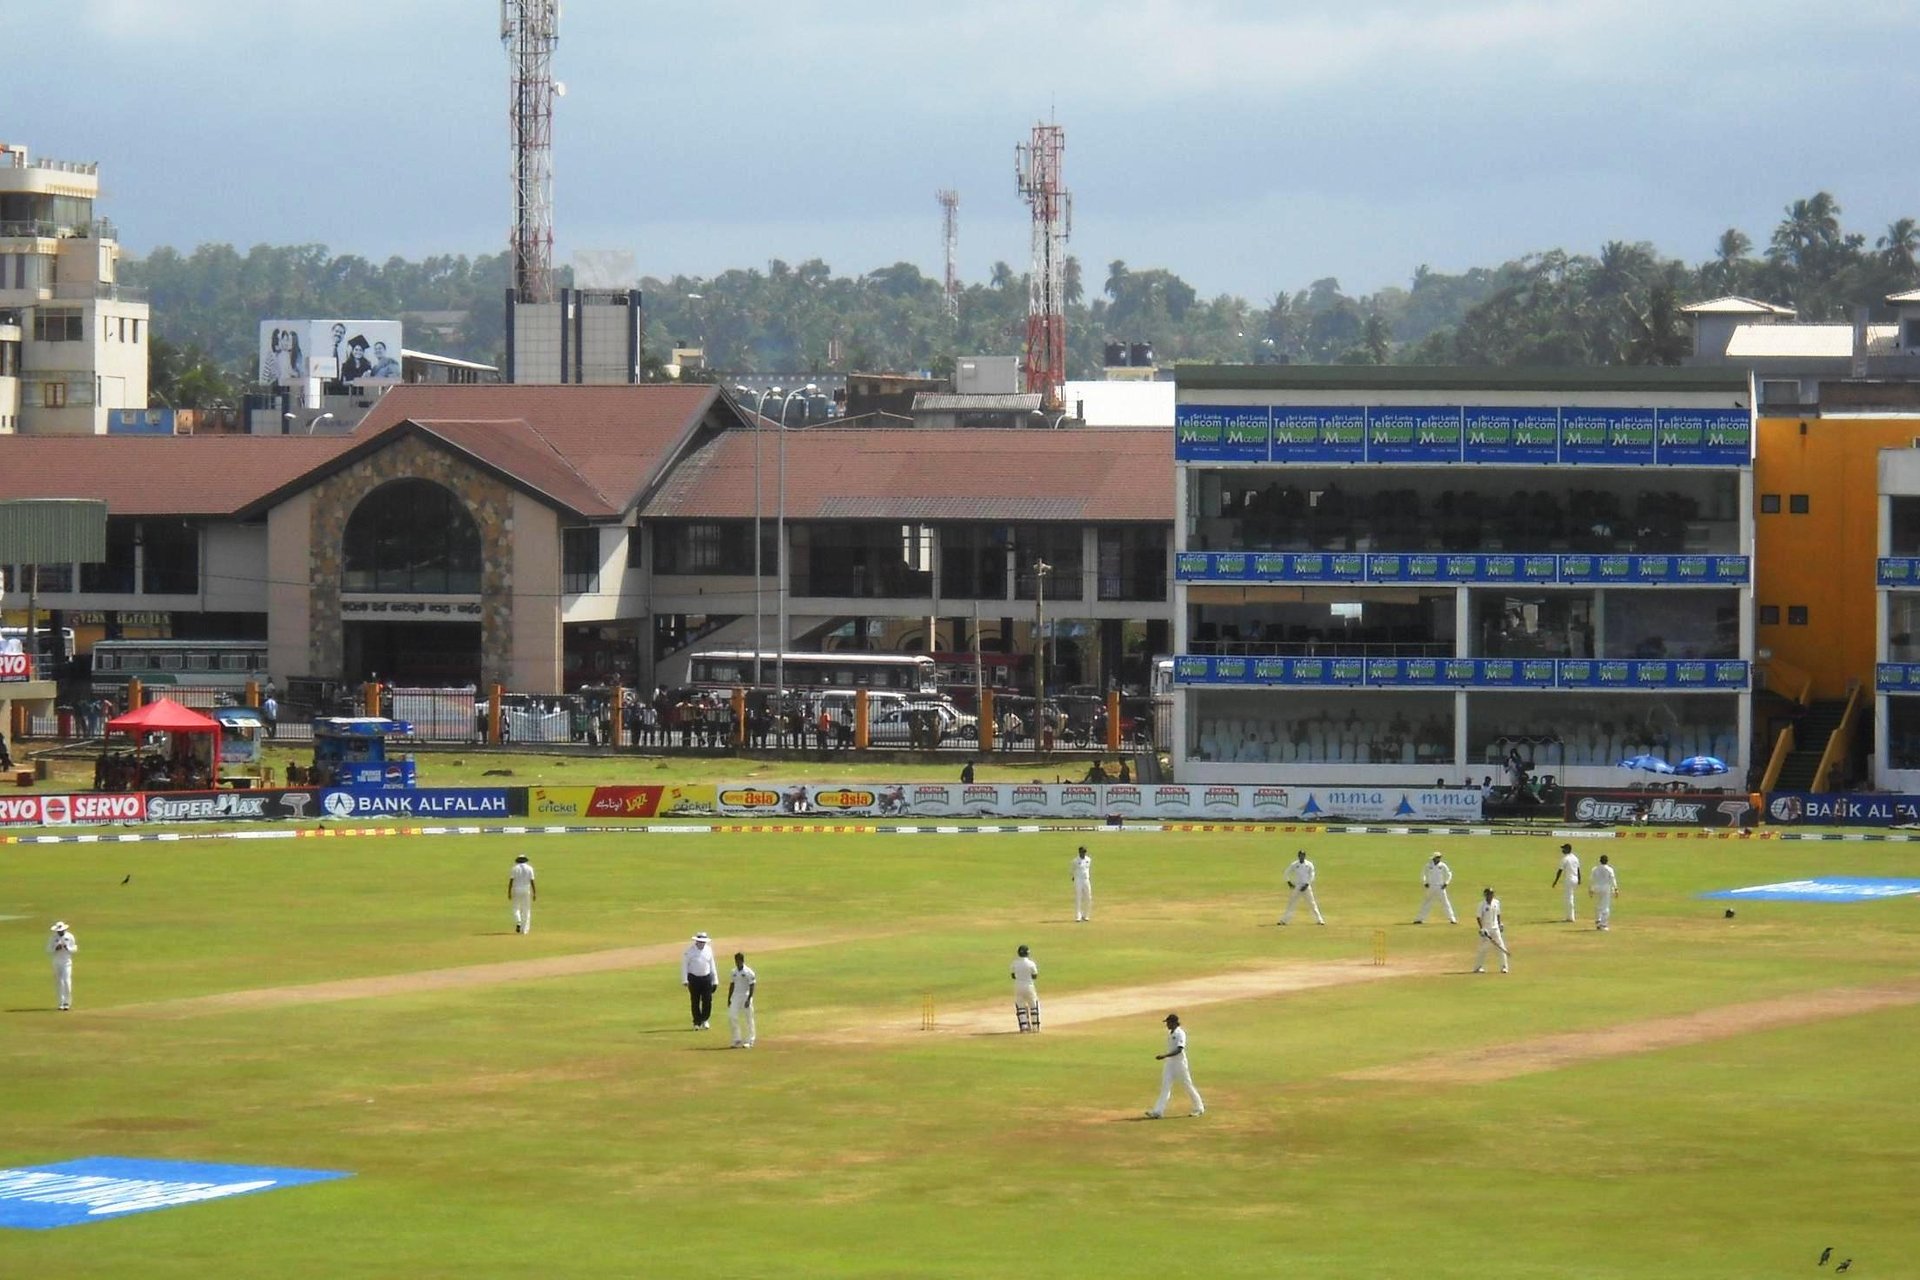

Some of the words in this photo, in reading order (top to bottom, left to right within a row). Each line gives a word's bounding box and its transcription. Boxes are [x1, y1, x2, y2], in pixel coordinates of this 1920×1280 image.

[1178, 416, 1221, 427] Telecom
[1224, 417, 1267, 427] Telecom
[1274, 418, 1317, 428] Telecom
[1320, 418, 1363, 428] Telecom
[1370, 418, 1413, 428] Telecom
[1416, 418, 1459, 428] Telecom
[1466, 418, 1509, 428] Telecom
[1512, 418, 1555, 429] Telecom
[1562, 418, 1606, 429] Telecom
[1609, 419, 1652, 430] Telecom
[1658, 418, 1701, 429] Telecom
[1704, 419, 1748, 430] Telecom
[626, 793, 648, 811] Jazz
[745, 792, 773, 806] asia
[840, 792, 868, 806] asia
[1329, 792, 1384, 804] mma
[1422, 793, 1478, 806] mma
[75, 797, 139, 816] SERVO
[359, 798, 413, 810] BANK
[418, 798, 506, 810] ALFALAH
[538, 801, 577, 812] cricket
